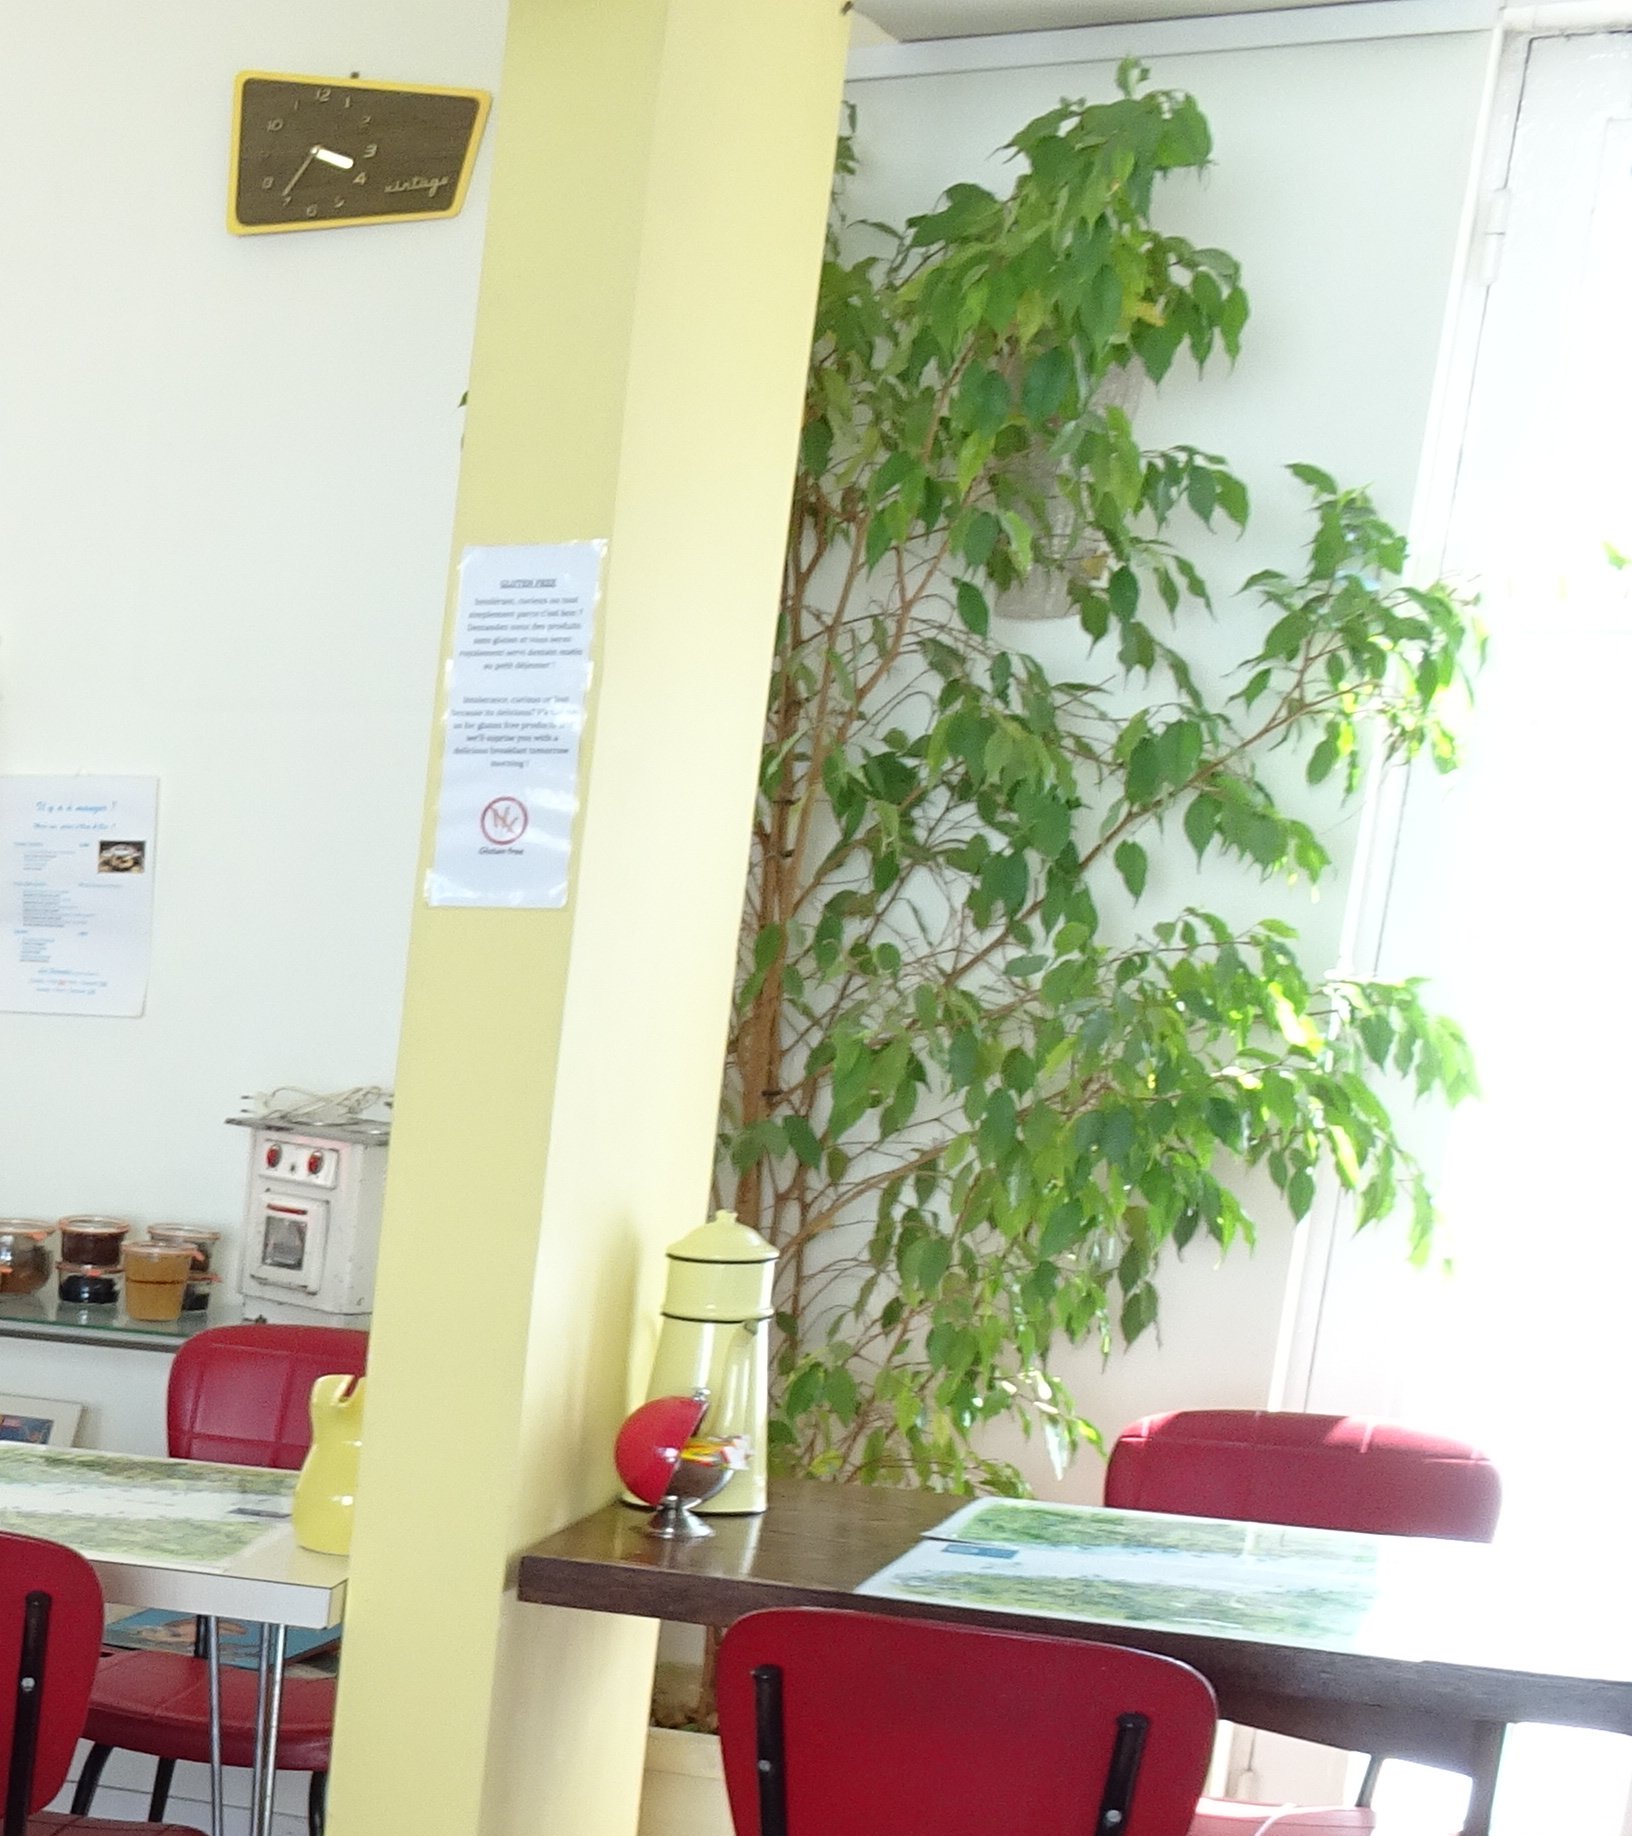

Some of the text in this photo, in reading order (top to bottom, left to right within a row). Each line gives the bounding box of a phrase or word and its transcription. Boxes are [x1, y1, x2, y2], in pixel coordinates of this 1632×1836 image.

[316, 87, 331, 102] 12
[344, 96, 351, 108] 1
[267, 119, 283, 131] 10
[363, 144, 377, 158] 3
[353, 172, 367, 185] 4
[384, 176, 449, 198] vintage
[307, 204, 317, 217] 6
[500, 579, 557, 588] GLUTEN FREE
